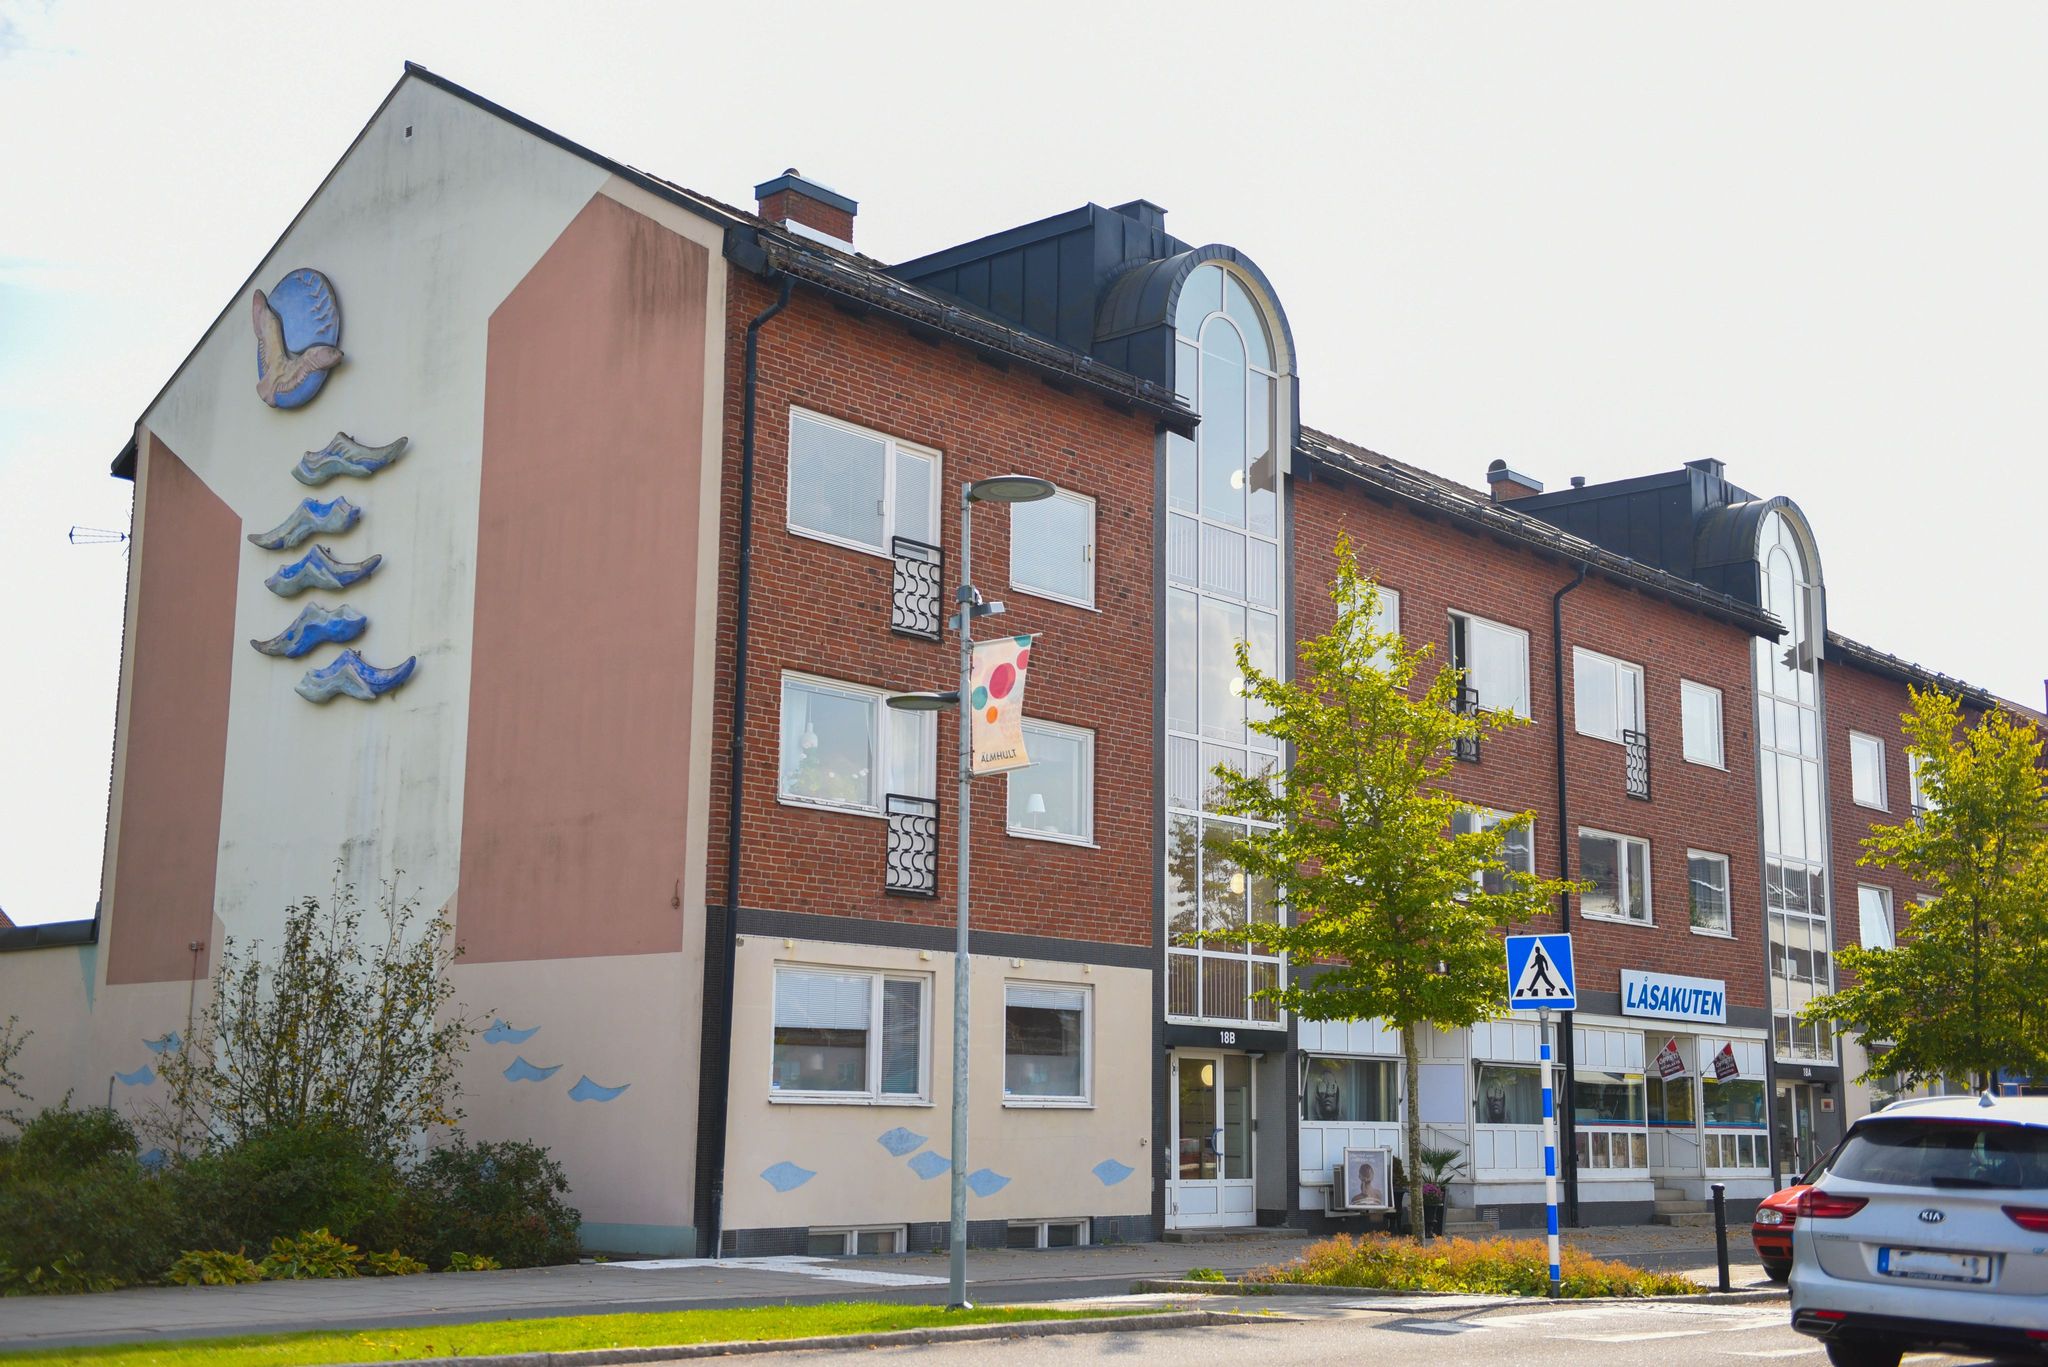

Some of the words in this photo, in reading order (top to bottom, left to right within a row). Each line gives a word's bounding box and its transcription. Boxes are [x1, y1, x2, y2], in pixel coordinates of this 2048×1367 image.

[981, 749, 1017, 763] ÄLMHULT
[1627, 976, 1723, 1016] LÅSAKUTEN
[1220, 1031, 1236, 1044] 18B
[1921, 1211, 1940, 1221] KIA
